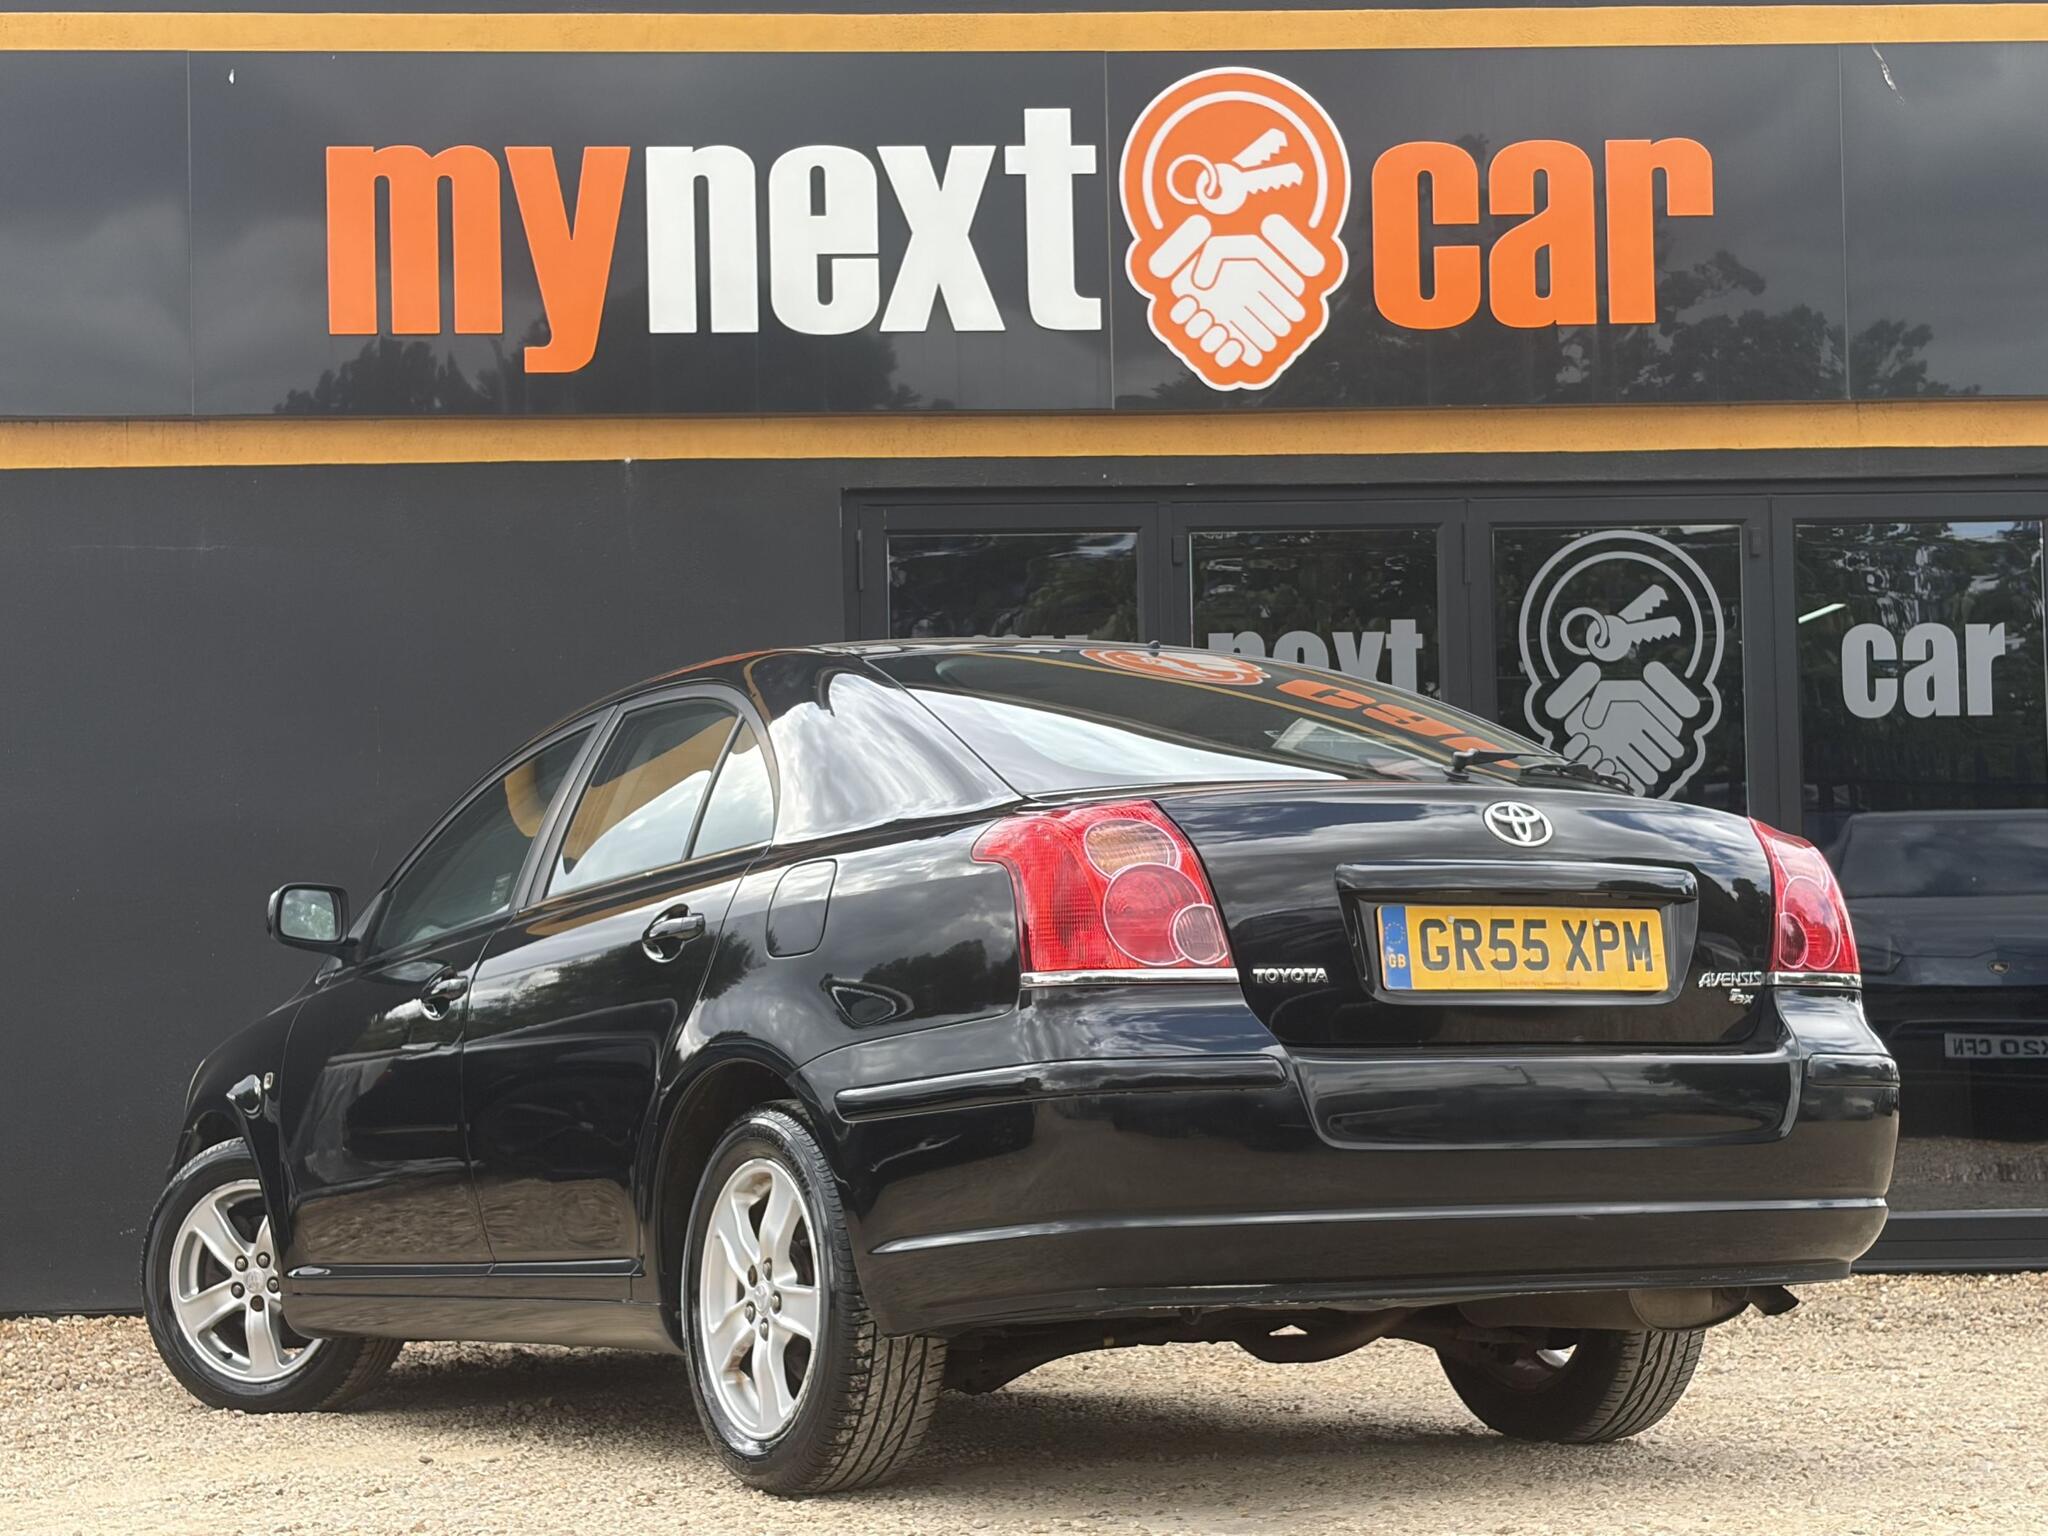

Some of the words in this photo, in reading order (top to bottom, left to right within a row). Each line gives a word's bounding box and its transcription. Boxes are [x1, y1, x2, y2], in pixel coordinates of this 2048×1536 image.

[1371, 137, 1714, 330] car
[1841, 622, 2006, 719] car
[1418, 918, 1551, 972] GR55
[1561, 919, 1654, 972] XPM
[1252, 967, 1329, 984] TOYOTA
[1698, 970, 1762, 988] AVENSIS
